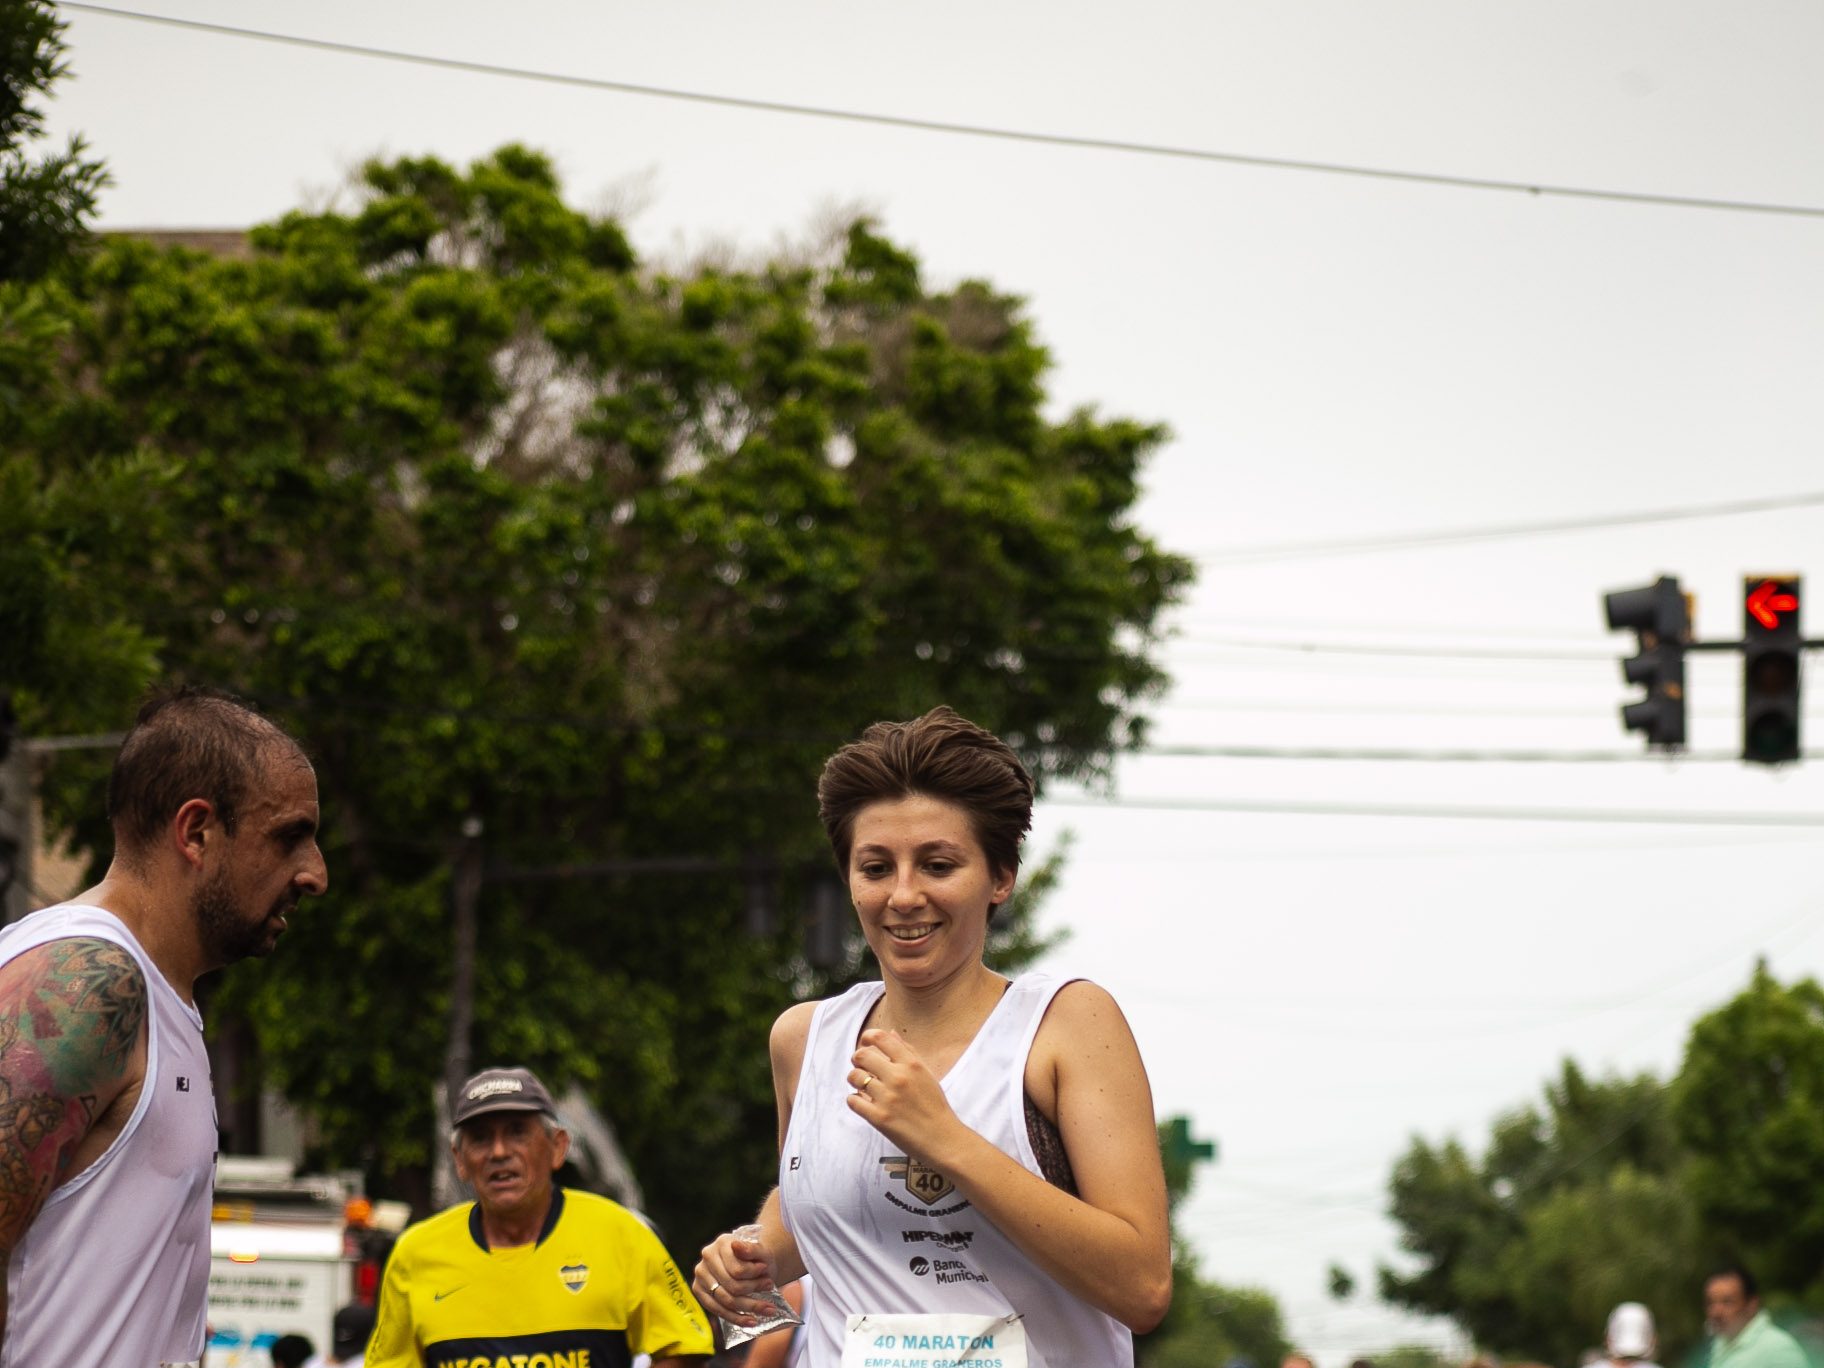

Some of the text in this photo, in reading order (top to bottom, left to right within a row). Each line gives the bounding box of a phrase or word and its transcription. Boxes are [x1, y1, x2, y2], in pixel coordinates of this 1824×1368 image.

[915, 1172, 944, 1193] 40
[874, 1335, 995, 1350] 40 MARATON
